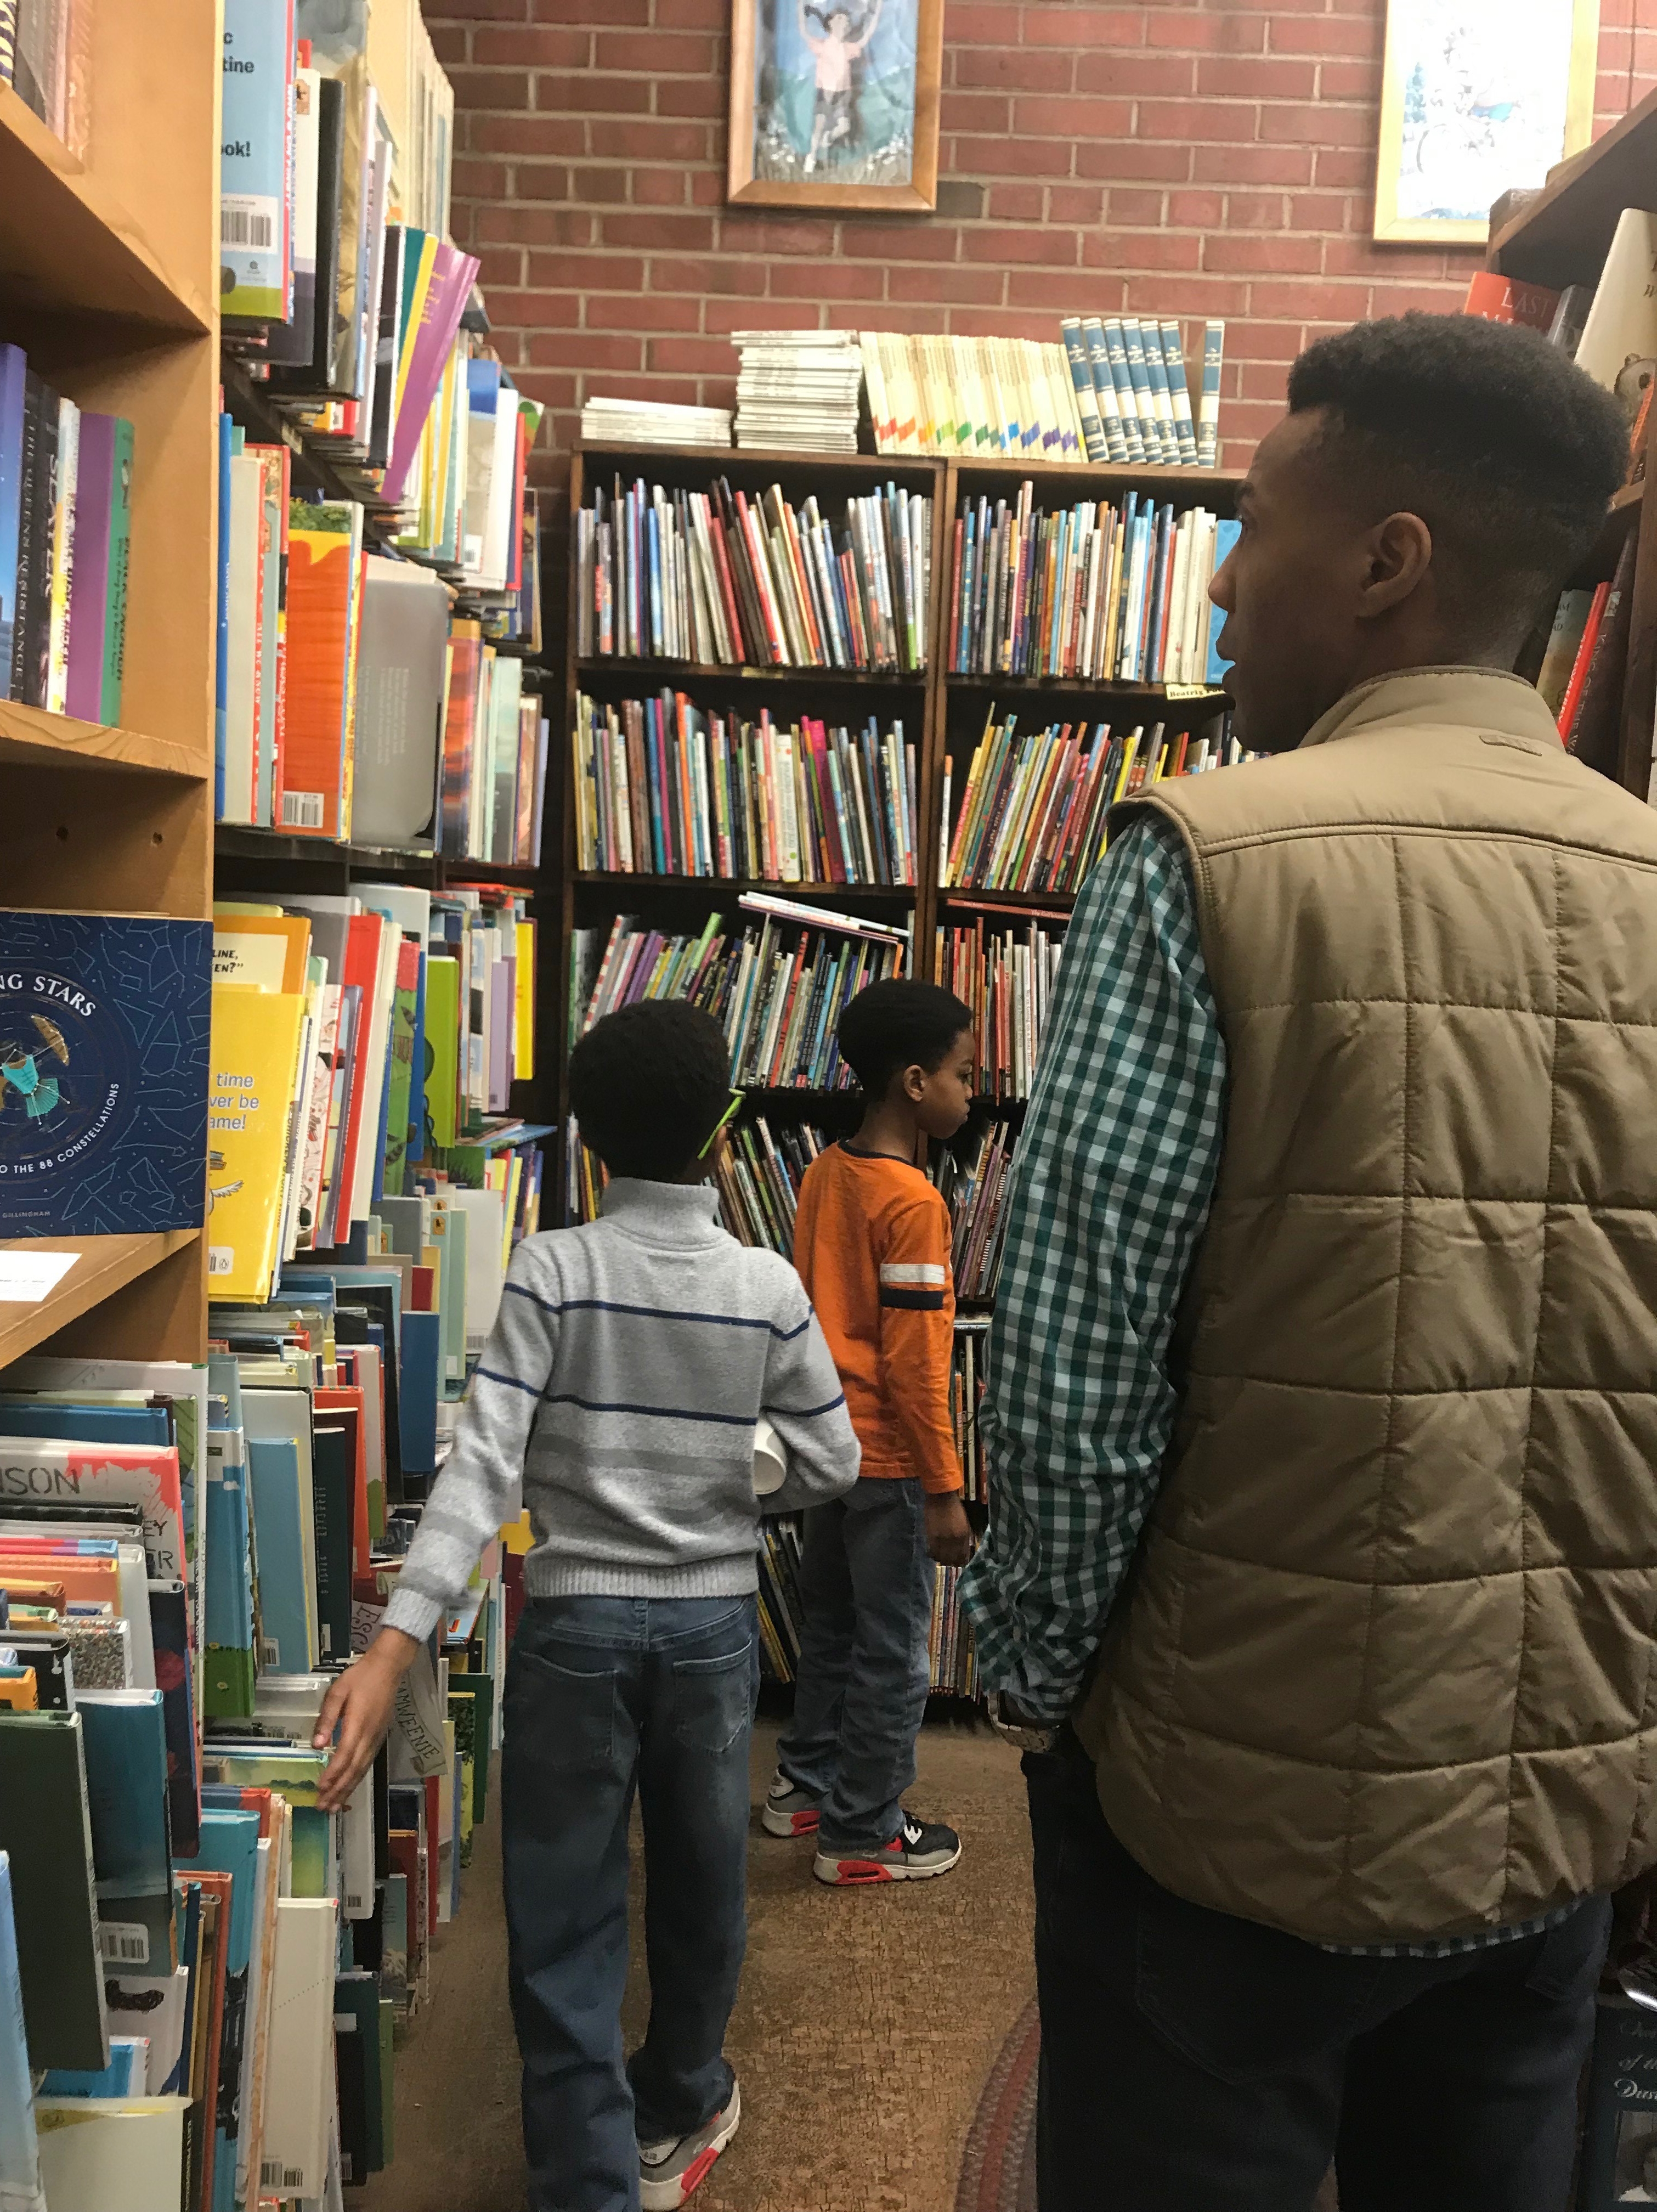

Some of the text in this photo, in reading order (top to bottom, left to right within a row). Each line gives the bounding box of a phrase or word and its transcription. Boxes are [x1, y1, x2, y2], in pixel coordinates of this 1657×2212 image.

[1501, 286, 1550, 318] LAST
[33, 976, 96, 1016] STARS
[217, 1072, 253, 1087] time
[239, 1093, 259, 1109] be
[14, 1164, 34, 1173] THE
[39, 1159, 53, 1170] 88
[57, 1083, 120, 1163] CONSTELLATIONS
[0, 1466, 80, 1496] SON
[394, 1681, 440, 1759] AMWEENIE
